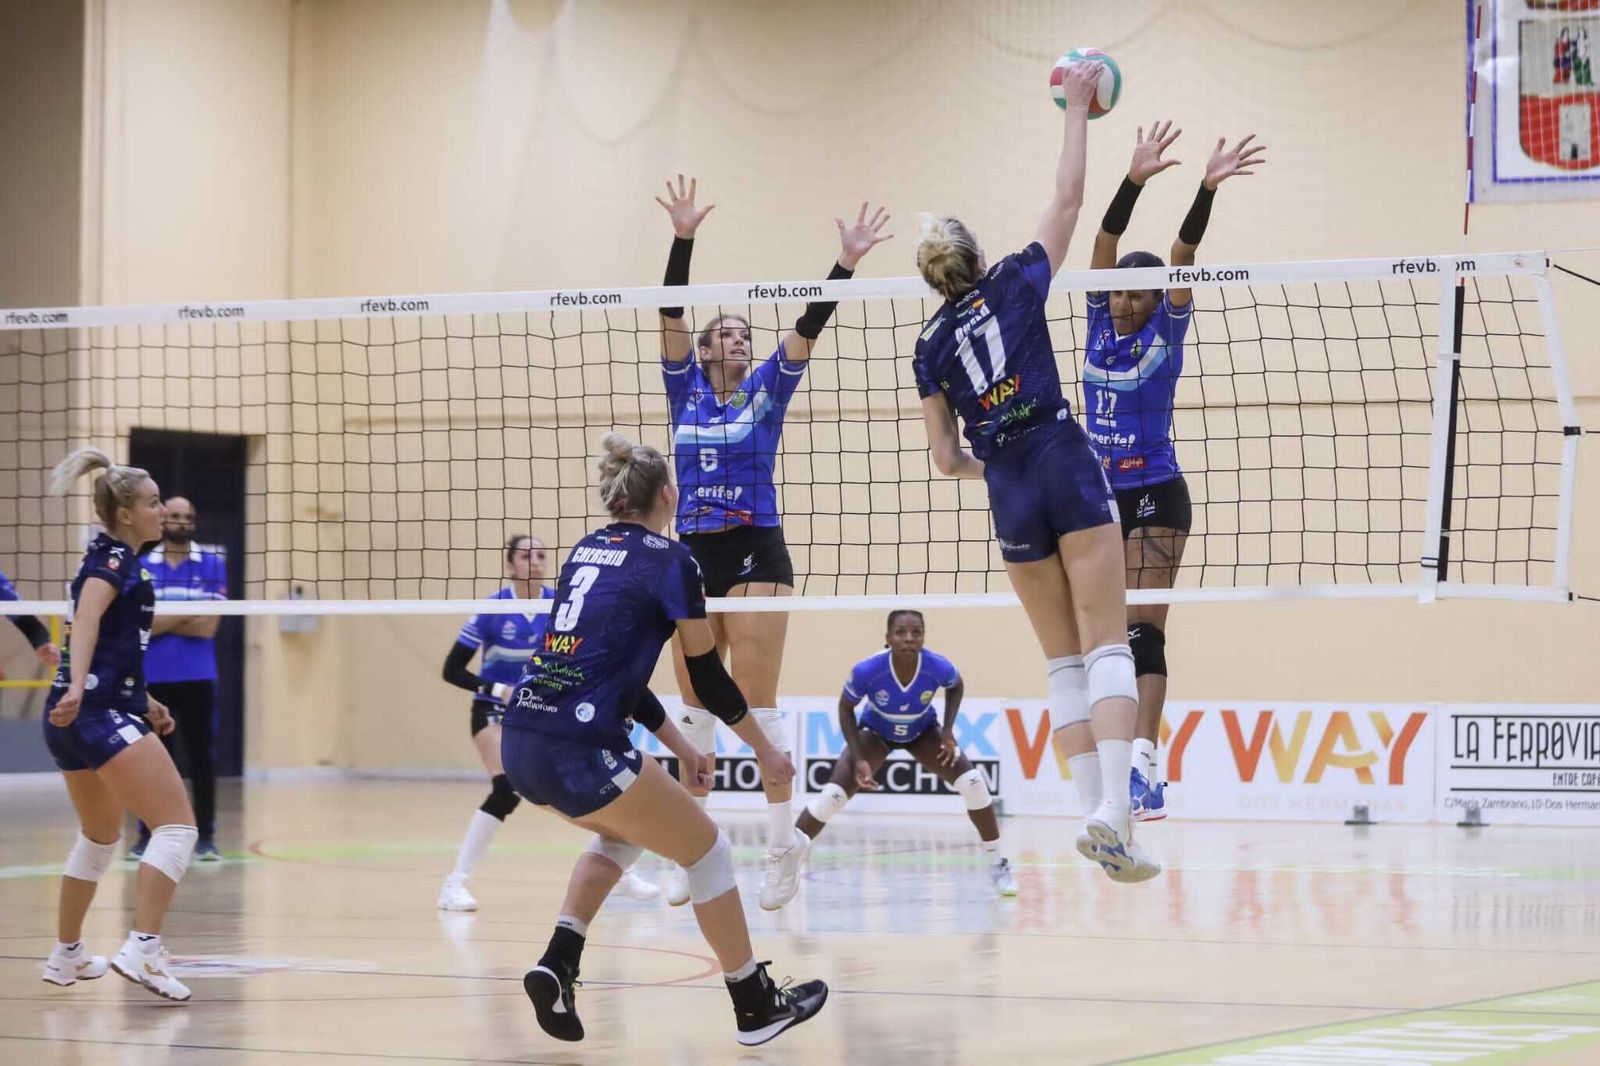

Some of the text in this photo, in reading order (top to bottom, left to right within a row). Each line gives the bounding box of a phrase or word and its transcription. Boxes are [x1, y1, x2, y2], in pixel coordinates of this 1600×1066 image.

[1169, 268, 1249, 283] rfevb.com
[1393, 259, 1476, 274] rfevb.m
[550, 292, 622, 306] rfevb.com
[748, 284, 823, 298] rfevb.com
[179, 306, 245, 319] rfevb.com
[360, 299, 429, 312] rfevb.com
[5, 312, 68, 325] rfevb.com
[955, 314, 1006, 397] 17
[978, 374, 1021, 412] WAY
[1095, 390, 1117, 418] 17
[554, 566, 600, 632] 3
[544, 633, 584, 654] WAY
[806, 711, 1000, 756] MX
[894, 724, 908, 736] 5
[1454, 716, 1479, 762] LA
[1005, 709, 1205, 782] WY
[1220, 710, 1428, 785] WAY
